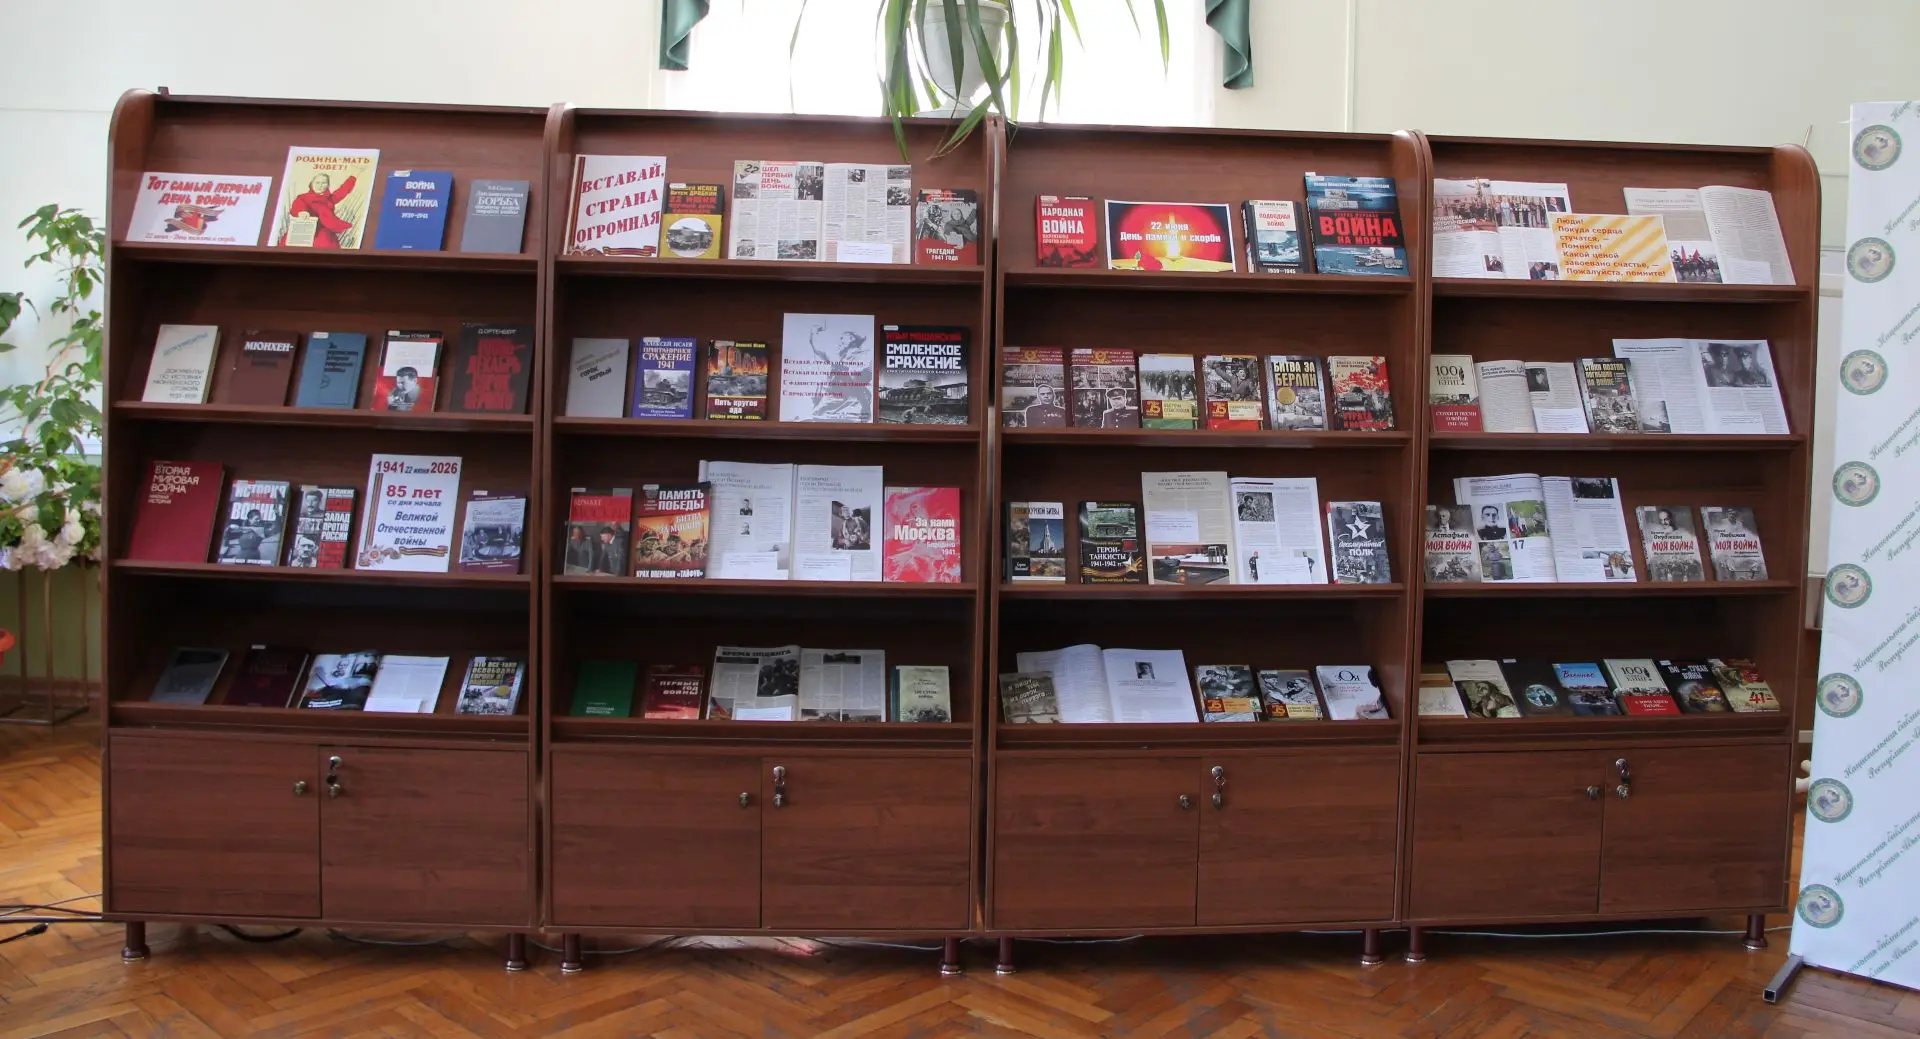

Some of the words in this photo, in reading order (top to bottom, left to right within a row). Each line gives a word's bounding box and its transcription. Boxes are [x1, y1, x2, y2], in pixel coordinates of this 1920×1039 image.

[295, 155, 370, 164] РОДИНА-МАТЬ
[312, 163, 348, 171] ЗОВЕТ!
[405, 181, 436, 190] ВОЙНА
[395, 199, 439, 208] ПОЛИТИКА
[478, 197, 519, 206] БОРЬБА
[585, 188, 658, 217] СТРАНА
[1041, 208, 1083, 217] НАРОДНАЯ
[577, 210, 660, 243] ОГРОМНАЯ
[1042, 219, 1085, 234] ВОЙНА
[1164, 223, 1188, 231] июня
[1319, 216, 1398, 237] ВОЙНА
[1556, 218, 1583, 226] Люди!
[1558, 226, 1590, 234] Покуда
[1120, 232, 1142, 241] День
[1189, 234, 1220, 243] скорби
[1337, 236, 1352, 244] НА
[1355, 237, 1382, 245] МОРЕ
[1562, 242, 1602, 250] Помните!
[1563, 251, 1590, 259] Какой
[1592, 252, 1619, 260] ценой
[1566, 268, 1624, 276] Пожалуйста,
[244, 341, 294, 351] МЮНХЕН-
[886, 343, 962, 356] СМОЛЕНСКОЕ
[642, 353, 692, 361] СРАЖЕНИЕ
[657, 361, 676, 369] 1941
[886, 356, 962, 370] СРАЖЕНИЕ
[1273, 361, 1301, 372] БИТВА
[1304, 361, 1316, 372] ЗА
[1435, 365, 1459, 376] 100
[1274, 373, 1317, 387] БЕРЛИН
[714, 398, 731, 406] Пять
[733, 399, 757, 408] кругов
[154, 465, 191, 475] ВТОРАЯ
[375, 461, 404, 473] 1941
[429, 461, 457, 474] 2026
[152, 475, 199, 485] МИРОВАЯ
[151, 482, 187, 493] ВОЙНА
[385, 485, 406, 497] 85
[411, 487, 441, 498] лет
[659, 489, 704, 501] ПАМЯТЬ
[658, 500, 704, 511] ПОБЕДЫ
[324, 513, 351, 522] ЗАПАД
[394, 510, 437, 521] Великой
[322, 522, 349, 531] ПРОТИВ
[915, 517, 927, 526] За
[929, 518, 955, 528] нами
[376, 522, 444, 534] Отечественной
[894, 524, 955, 541] Москва
[320, 531, 348, 541] РОССИИ
[393, 535, 426, 545] войны
[1432, 532, 1469, 540] Астафьев
[1425, 541, 1443, 551] МОЯ
[1445, 540, 1472, 550] ВОЙНА
[1512, 540, 1526, 550] 17
[1651, 541, 1668, 551] МОЯ
[1670, 540, 1694, 550] ВОЙНА
[1714, 541, 1732, 550] МОЯ
[1733, 540, 1758, 550] ВОЙНА
[1348, 547, 1374, 556] ПОЛК
[1620, 666, 1644, 675] 100
